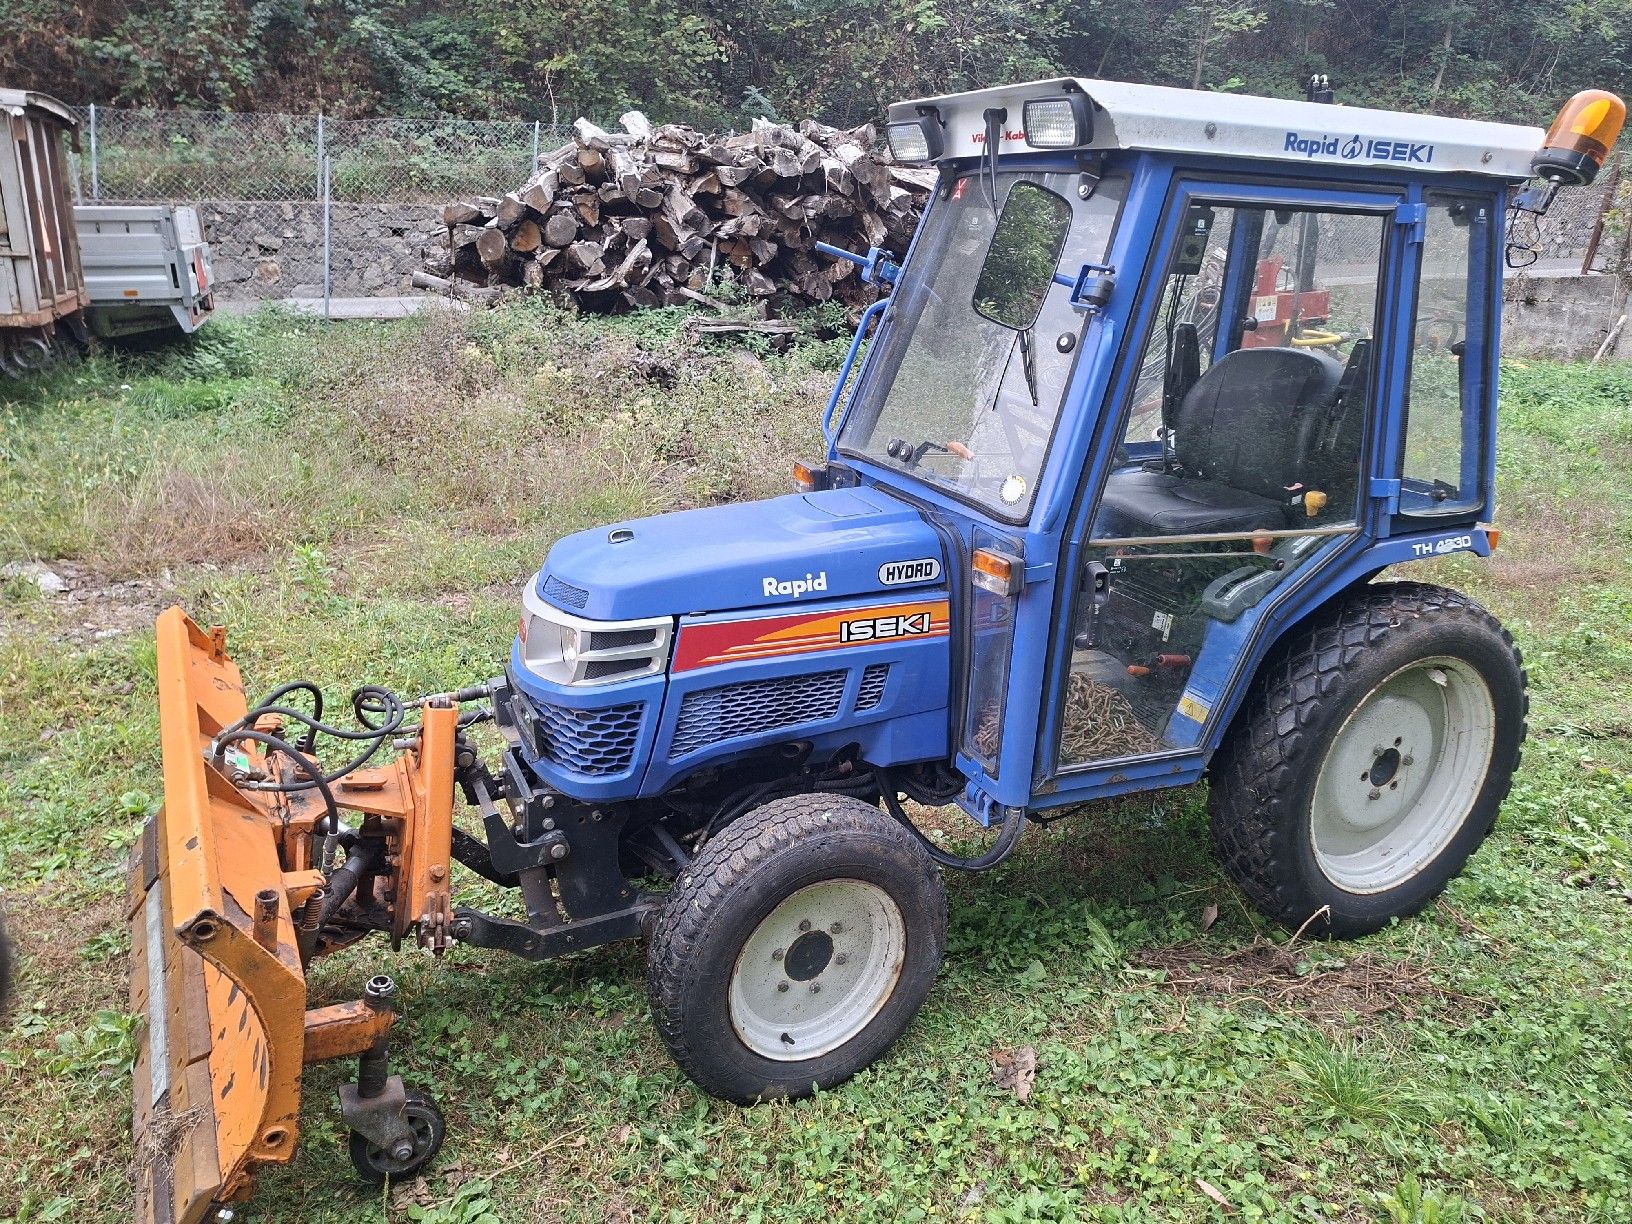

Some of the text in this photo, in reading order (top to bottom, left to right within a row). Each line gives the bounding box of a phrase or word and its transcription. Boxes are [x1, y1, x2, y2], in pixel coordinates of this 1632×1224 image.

[1284, 132, 1434, 163] Rapid ISEKI
[1412, 542, 1433, 556] TH
[762, 572, 828, 598] Rapid
[886, 562, 933, 582] HYDRO
[840, 612, 931, 643] ISEKI
